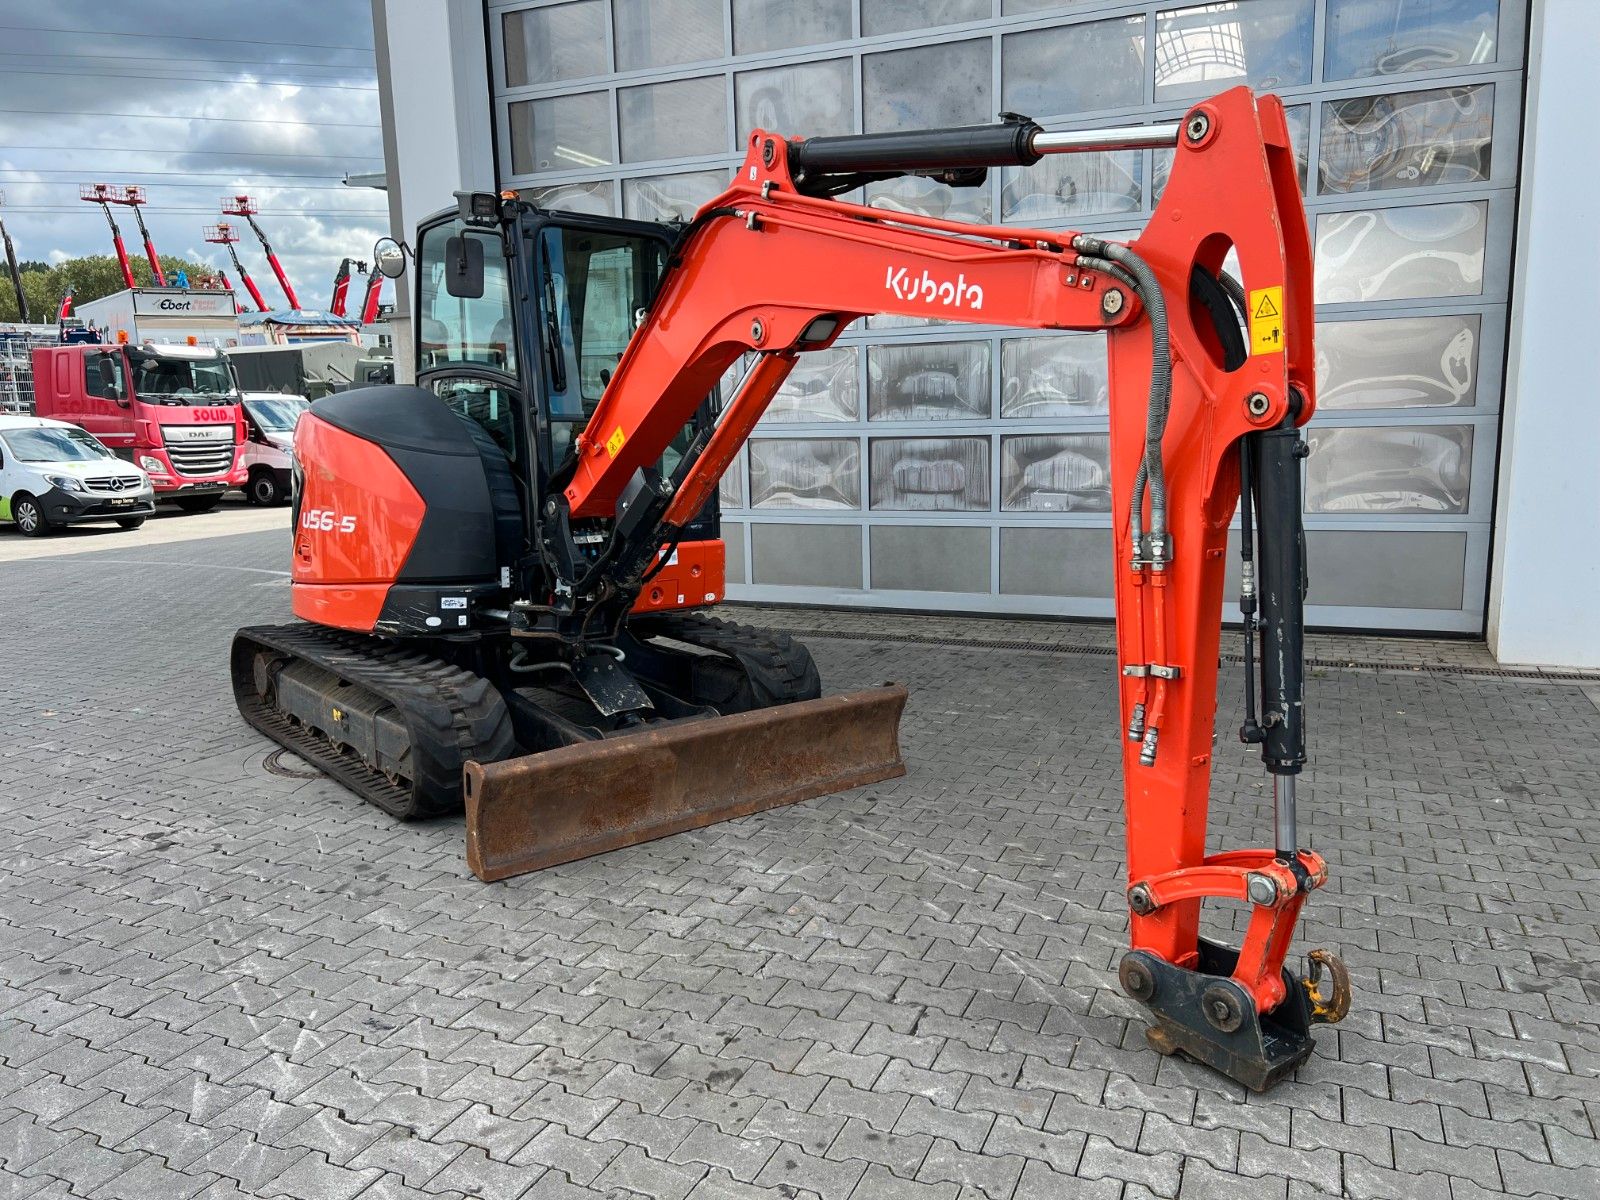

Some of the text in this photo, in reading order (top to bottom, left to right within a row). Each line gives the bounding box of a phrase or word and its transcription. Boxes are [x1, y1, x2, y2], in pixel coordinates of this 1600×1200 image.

[885, 265, 983, 310] Kubota
[160, 298, 191, 311] Ebert
[193, 409, 228, 421] SOLID
[302, 509, 357, 533] U56-5
